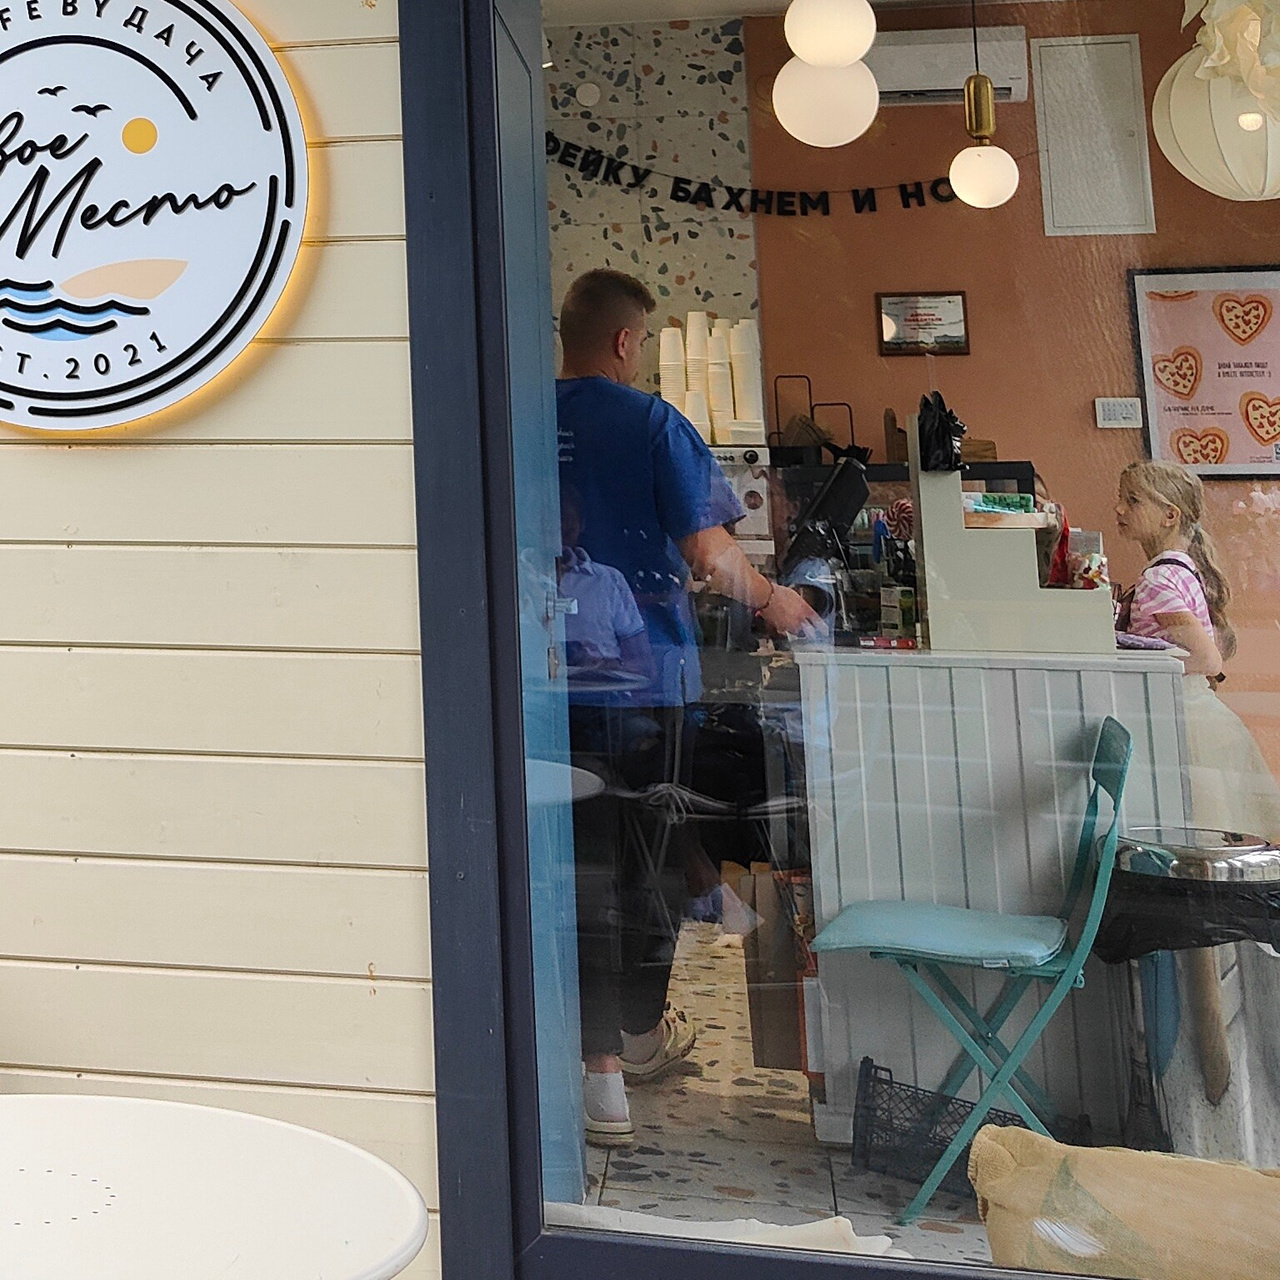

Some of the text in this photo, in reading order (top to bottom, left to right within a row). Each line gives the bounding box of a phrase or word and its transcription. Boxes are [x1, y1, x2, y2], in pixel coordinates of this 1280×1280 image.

[122, 5, 224, 93] ДАЧА
[669, 176, 831, 218] БАХНЕМ
[851, 187, 878, 214] И
[65, 331, 169, 381] 2021
